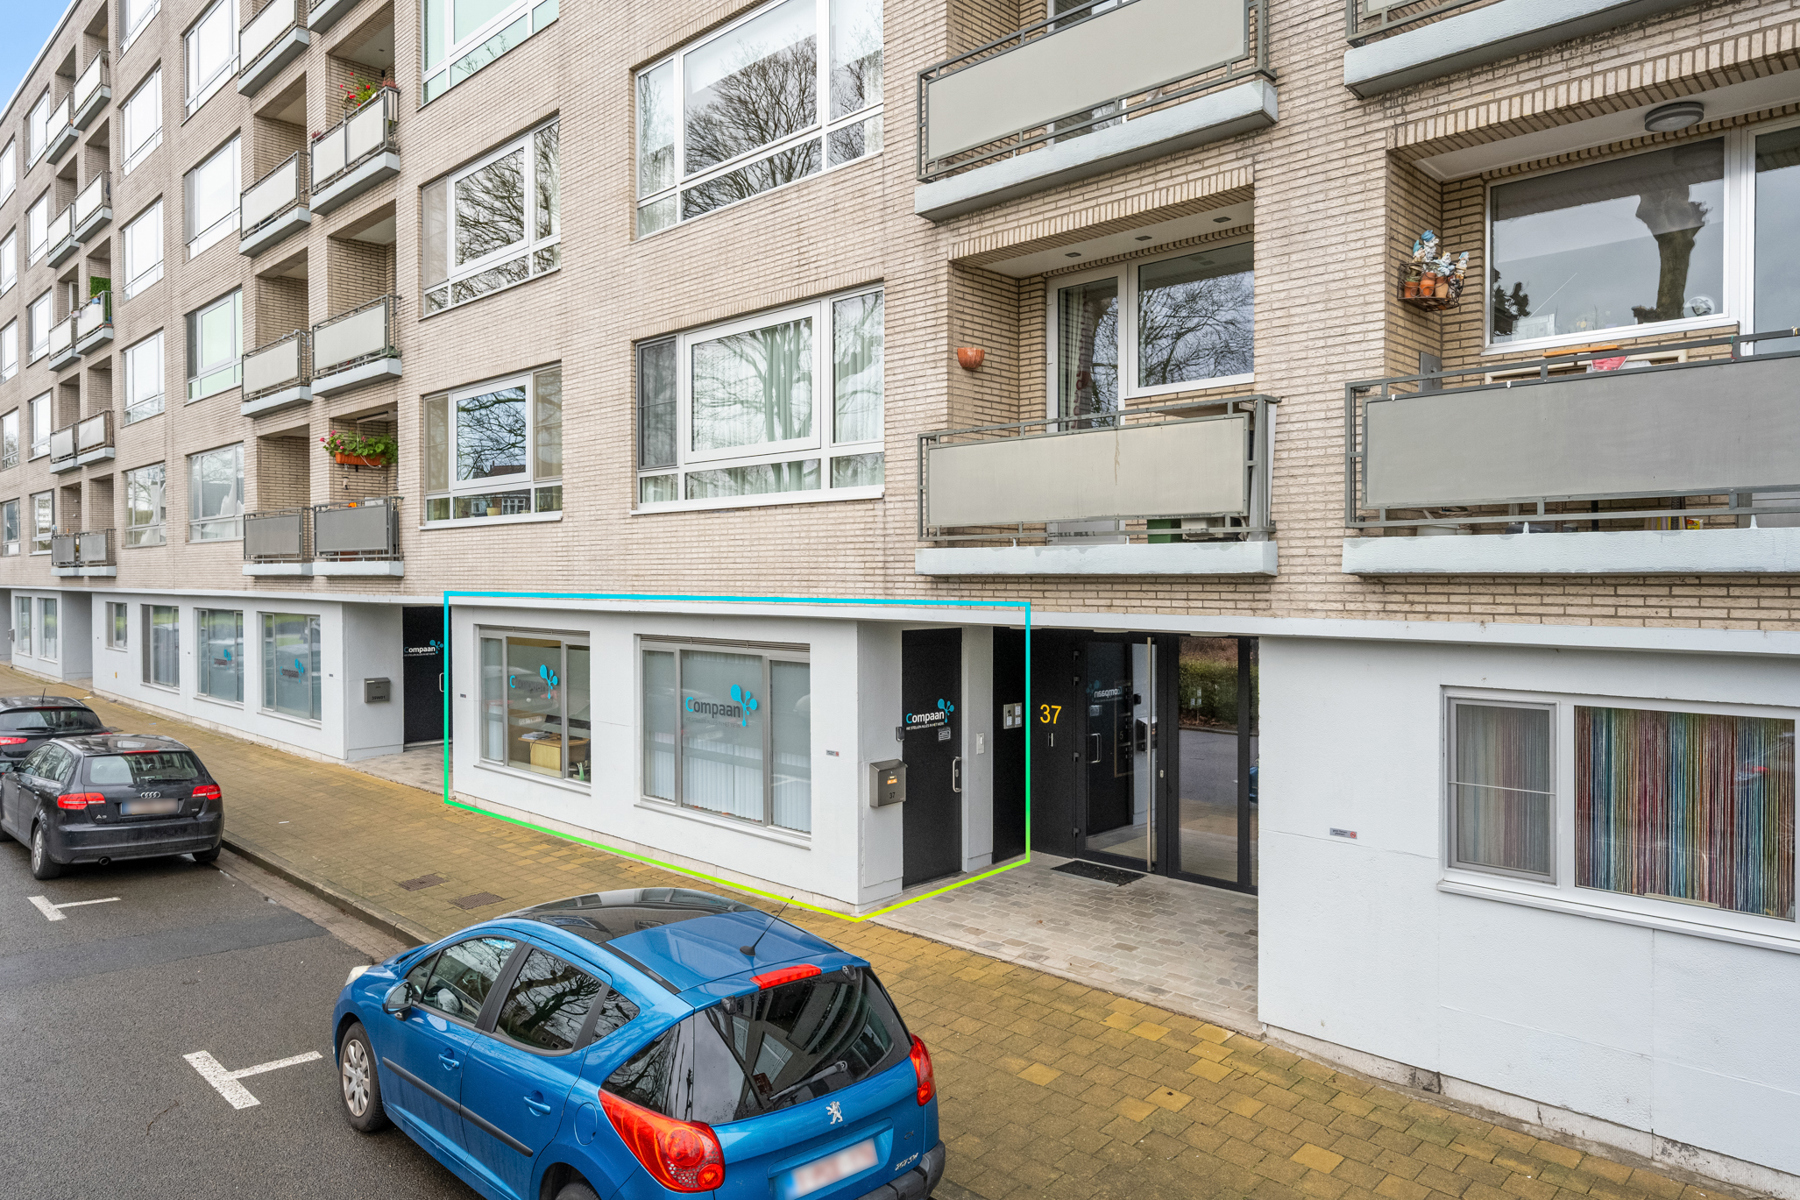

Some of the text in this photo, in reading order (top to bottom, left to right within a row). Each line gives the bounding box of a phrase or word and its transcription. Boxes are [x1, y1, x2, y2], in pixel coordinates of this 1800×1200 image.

[685, 696, 741, 719] Compaan
[1040, 704, 1062, 725] 37
[906, 711, 945, 724] Compaan
[889, 791, 896, 799] 37
